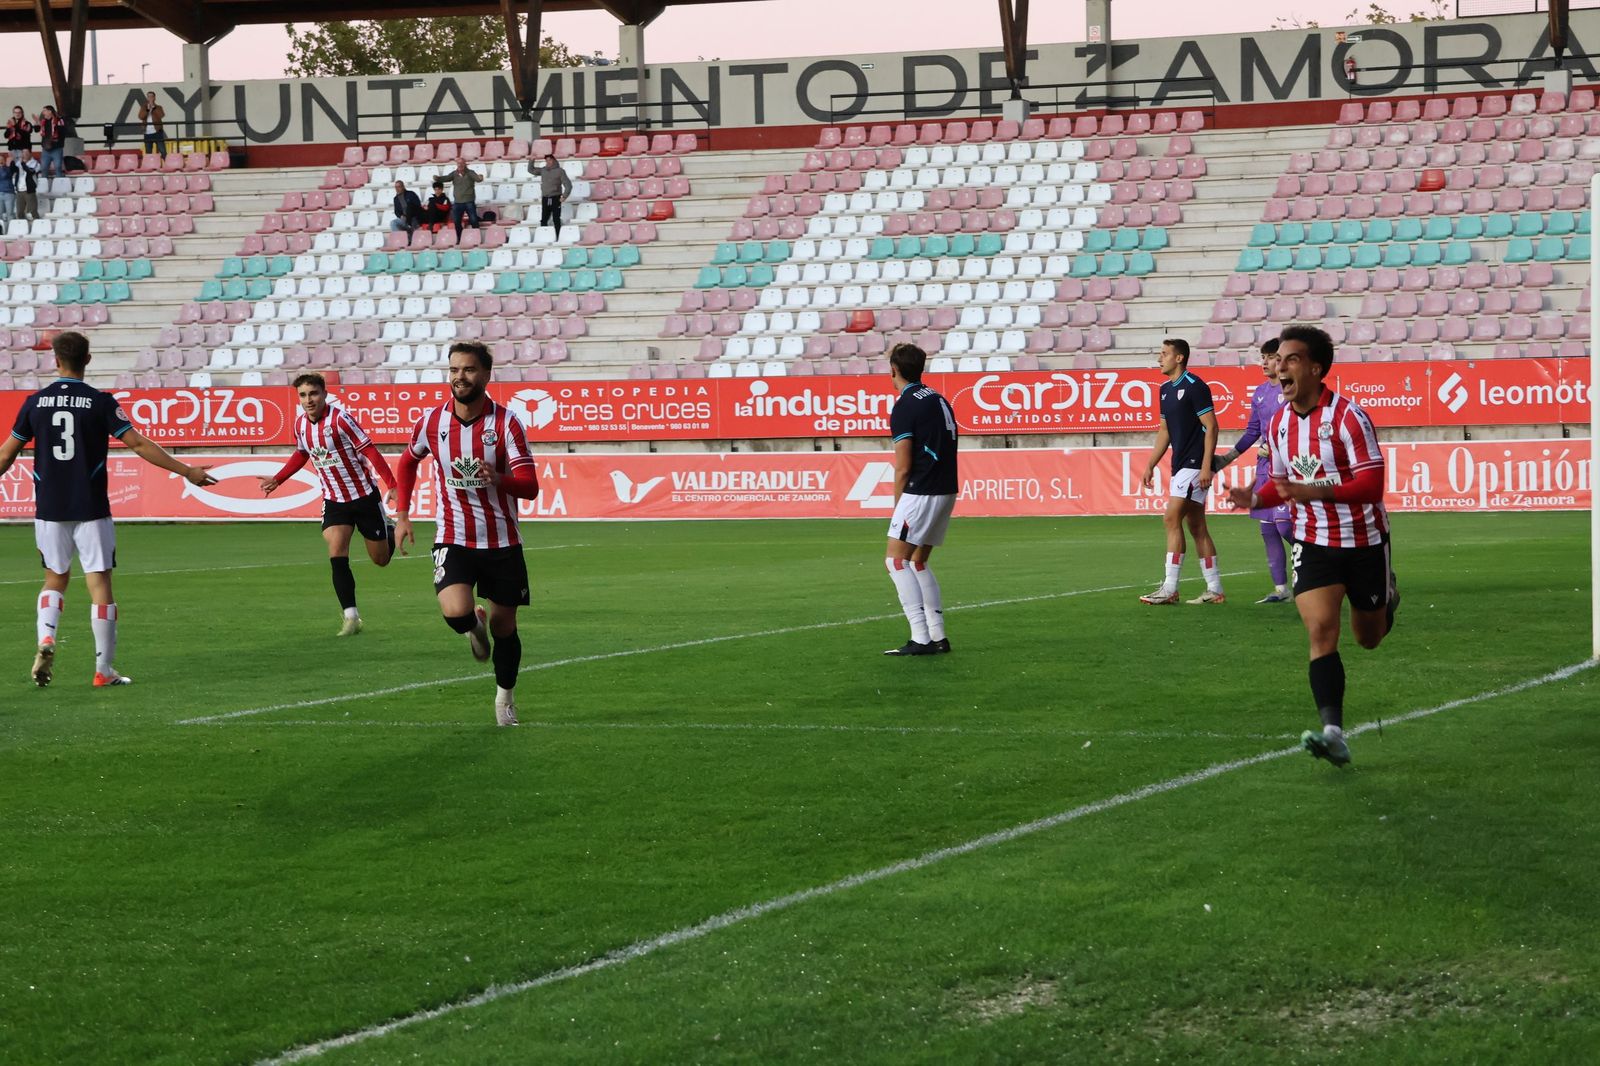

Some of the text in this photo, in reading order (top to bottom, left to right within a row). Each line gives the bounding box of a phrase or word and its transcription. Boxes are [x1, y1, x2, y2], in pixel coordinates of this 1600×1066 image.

[105, 22, 1600, 147] AYUNTAMIENTO DE ZAMORA
[560, 386, 708, 398] ORTOPEDIA
[1350, 382, 1386, 395] Grupo
[36, 395, 93, 409] JON DE LUIS
[1351, 394, 1423, 407] Leomotor
[558, 402, 711, 421] tres cruces
[735, 402, 753, 417] la
[814, 416, 841, 431] de
[939, 397, 957, 441] 4
[972, 412, 1153, 425] EMBUTIDOS Y JAMONES
[190, 428, 196, 437] Y
[201, 426, 265, 437] JAMONES
[558, 424, 583, 432] Zamora
[631, 423, 665, 431] Benavente
[52, 410, 75, 461] 3
[1121, 451, 1165, 497] La
[1387, 447, 1433, 494] La
[447, 478, 486, 487] CAJA RUR
[671, 470, 830, 491] VALDERADUEY
[1050, 477, 1083, 500] S.L.
[671, 493, 831, 502] EL CENTRO COMERCIAL DE ZAMORA
[1135, 498, 1151, 510] El
[1402, 493, 1576, 508] El Correo de Zamora
